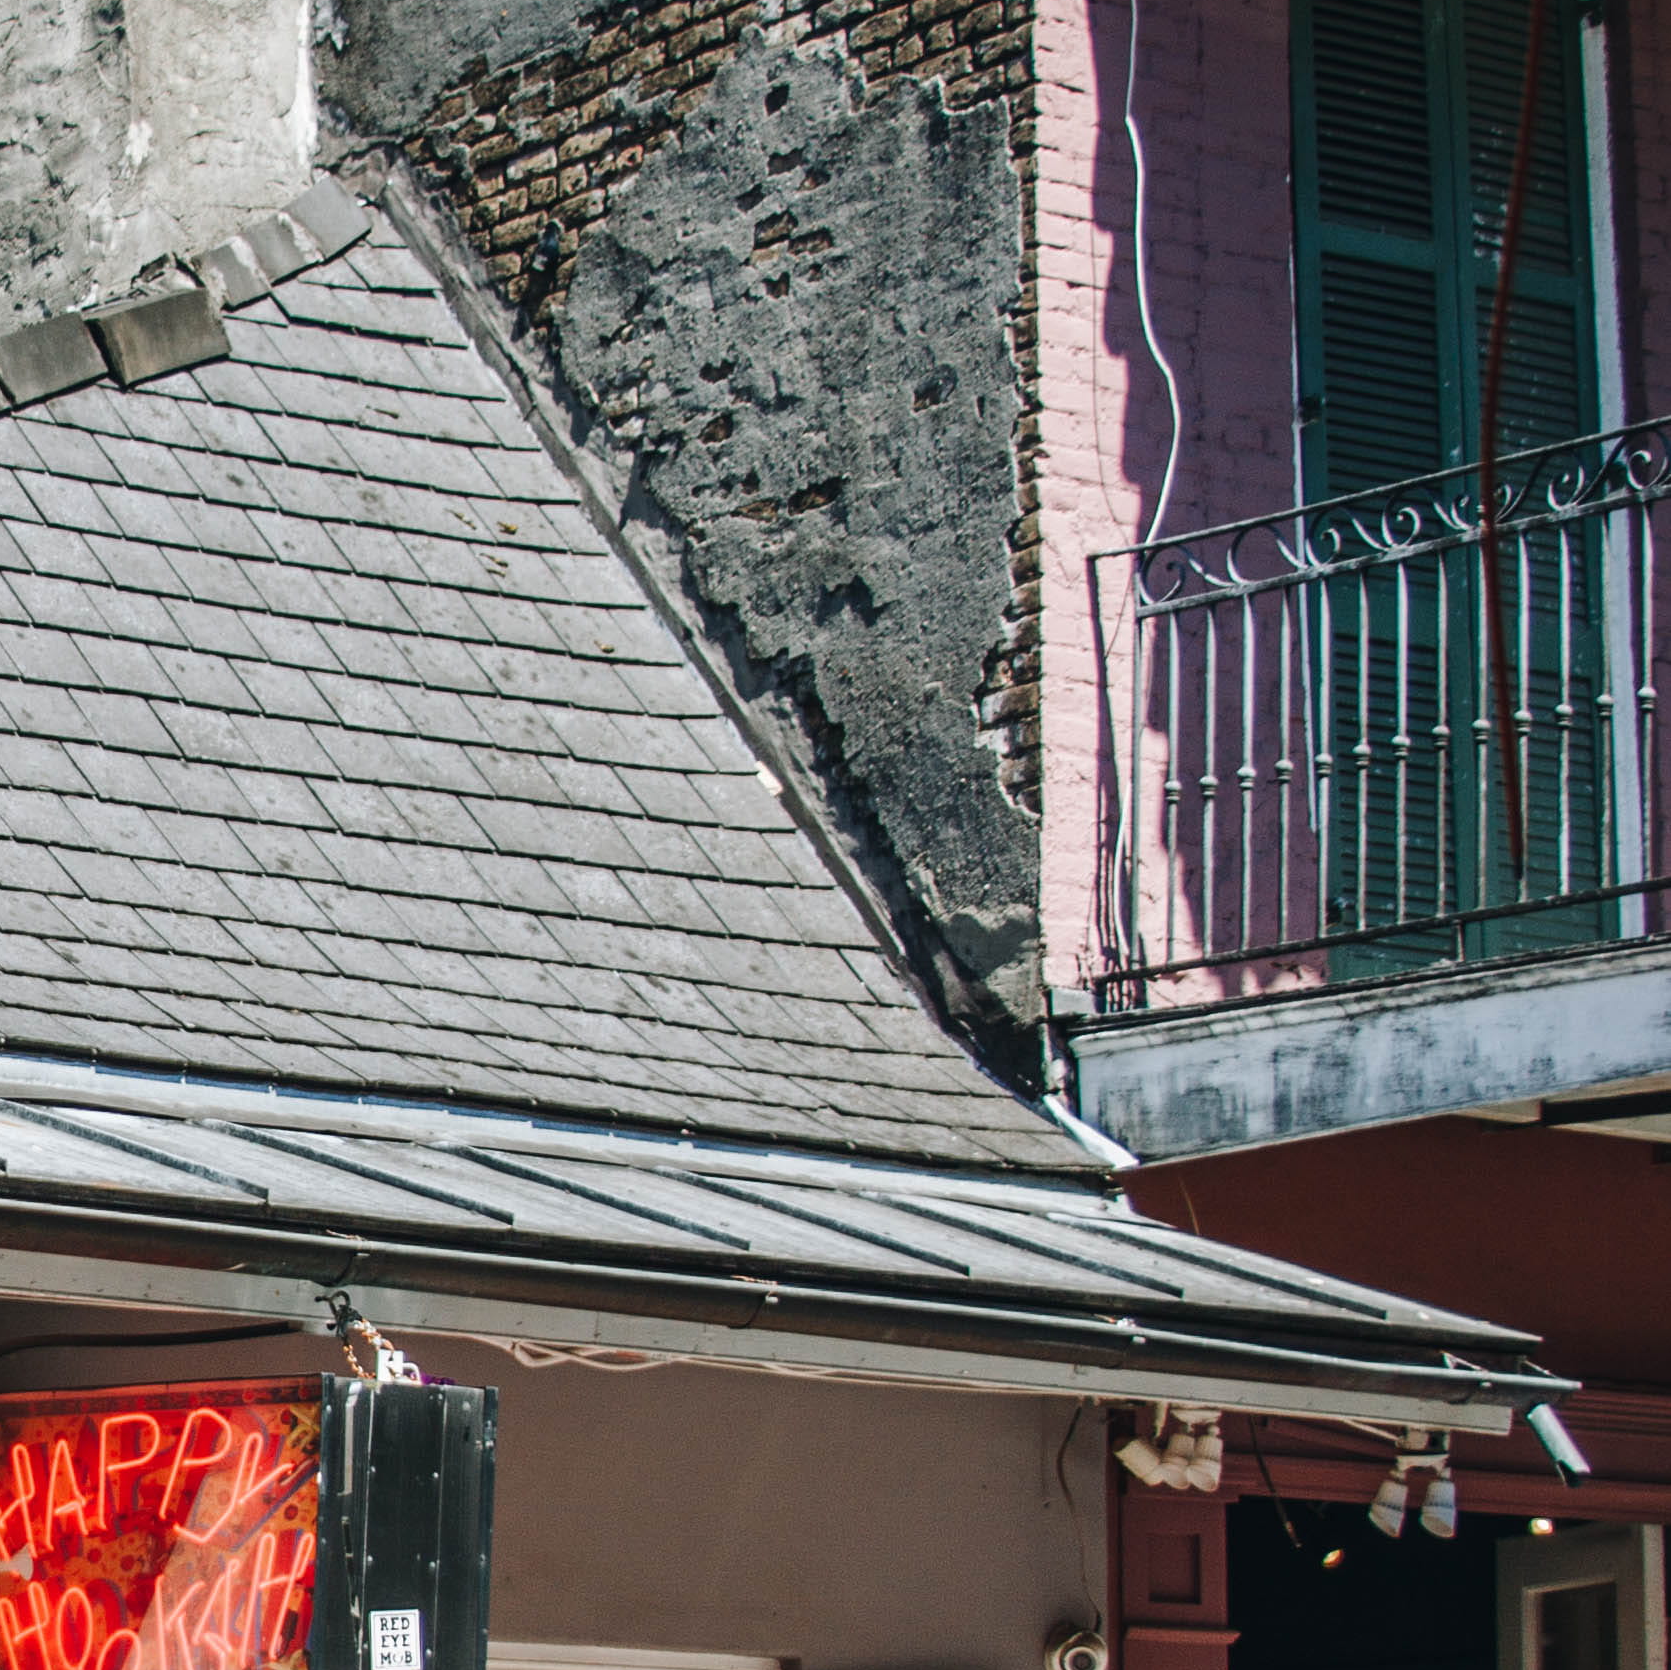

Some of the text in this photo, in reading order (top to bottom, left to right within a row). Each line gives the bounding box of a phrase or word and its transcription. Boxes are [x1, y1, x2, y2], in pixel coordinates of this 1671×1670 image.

[380, 1617, 410, 1632] RED
[381, 1634, 410, 1648] EYE
[380, 1651, 412, 1665] MOB
